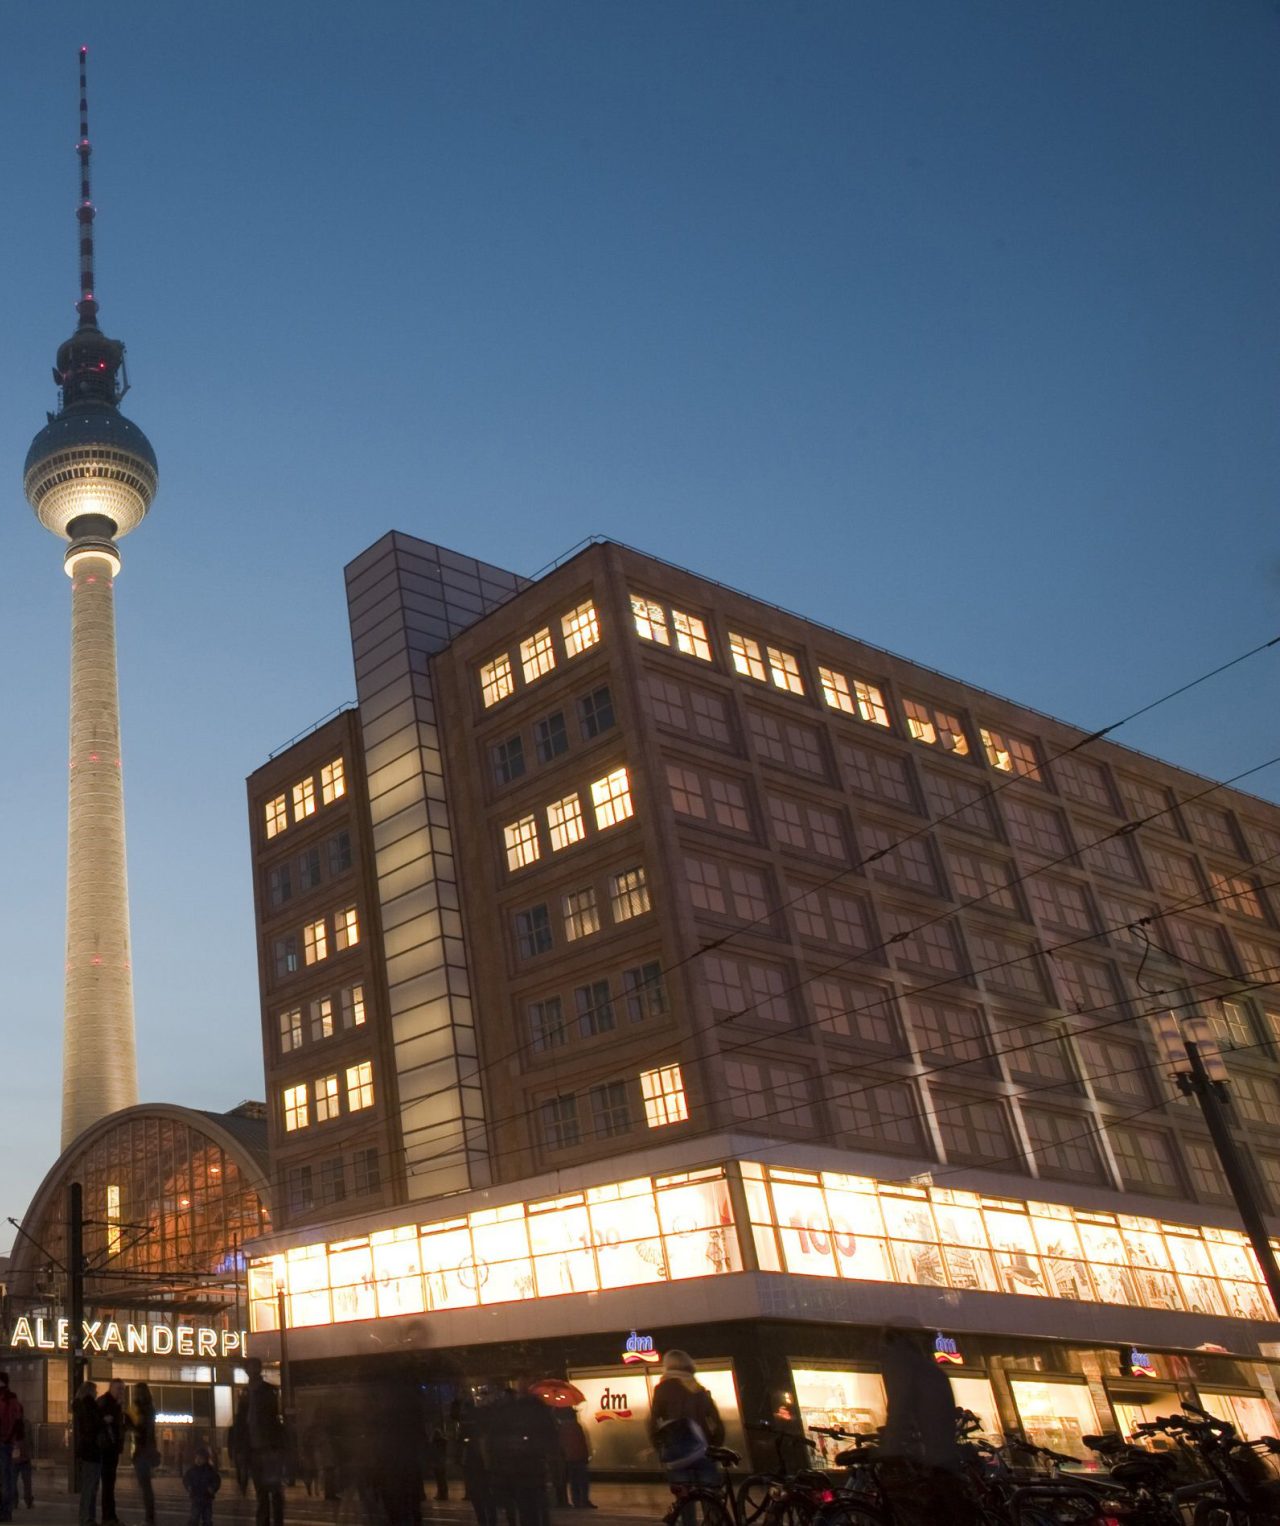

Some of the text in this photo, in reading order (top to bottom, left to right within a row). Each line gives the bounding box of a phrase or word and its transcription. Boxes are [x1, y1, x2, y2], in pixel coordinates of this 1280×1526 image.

[789, 1208, 856, 1258] 100
[626, 1331, 653, 1352] dm
[601, 1387, 628, 1410] dm
